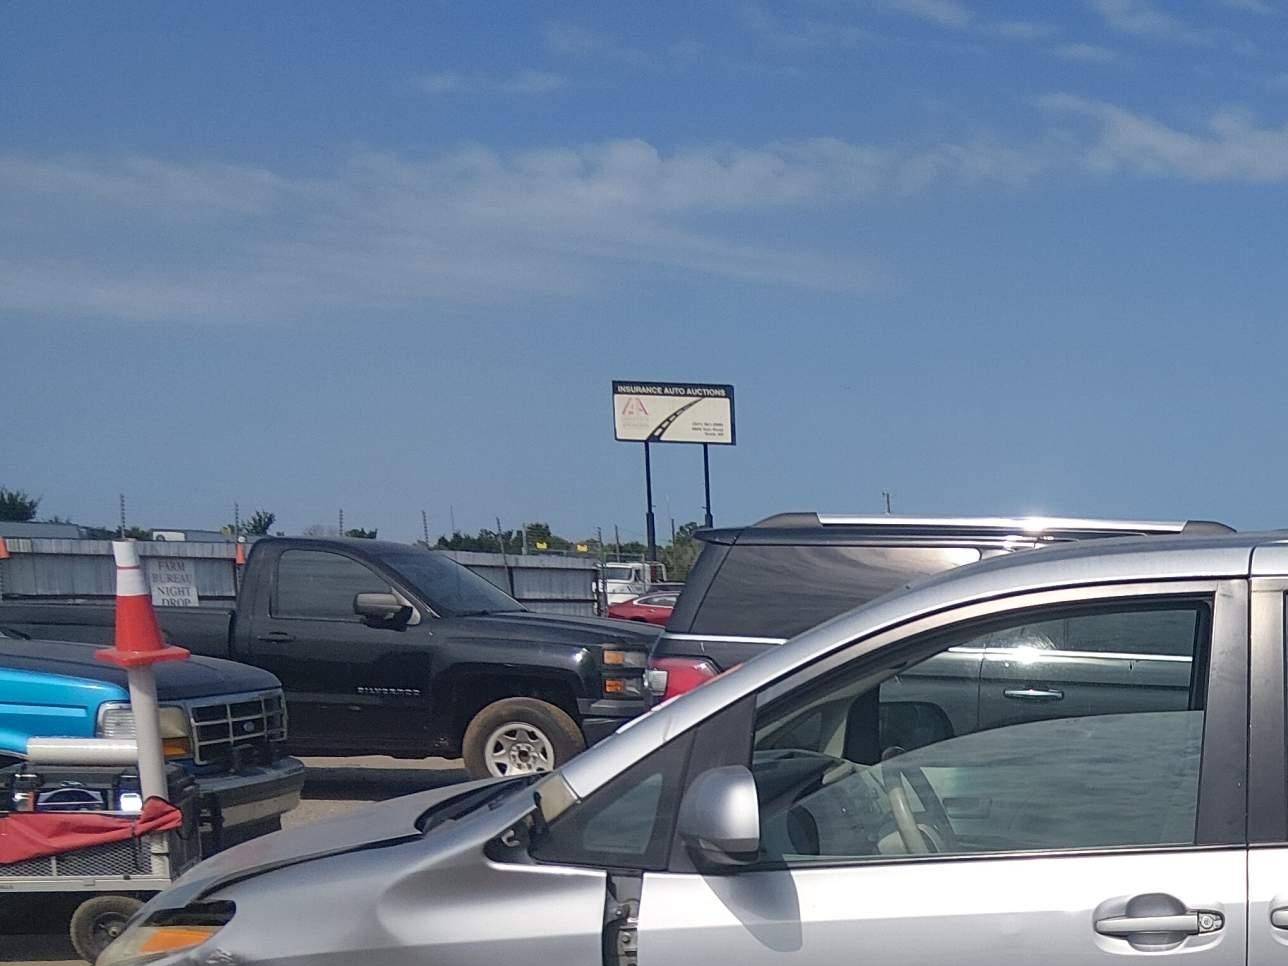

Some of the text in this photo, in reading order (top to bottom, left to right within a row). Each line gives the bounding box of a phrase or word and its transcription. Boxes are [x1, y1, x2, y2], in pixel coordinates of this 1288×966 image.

[617, 385, 726, 397] INSURANCE AUTO AUCTIONS
[158, 560, 185, 571] FARM
[151, 573, 193, 584] BUREAU
[157, 586, 191, 597] NIGHT
[161, 598, 192, 607] DROP
